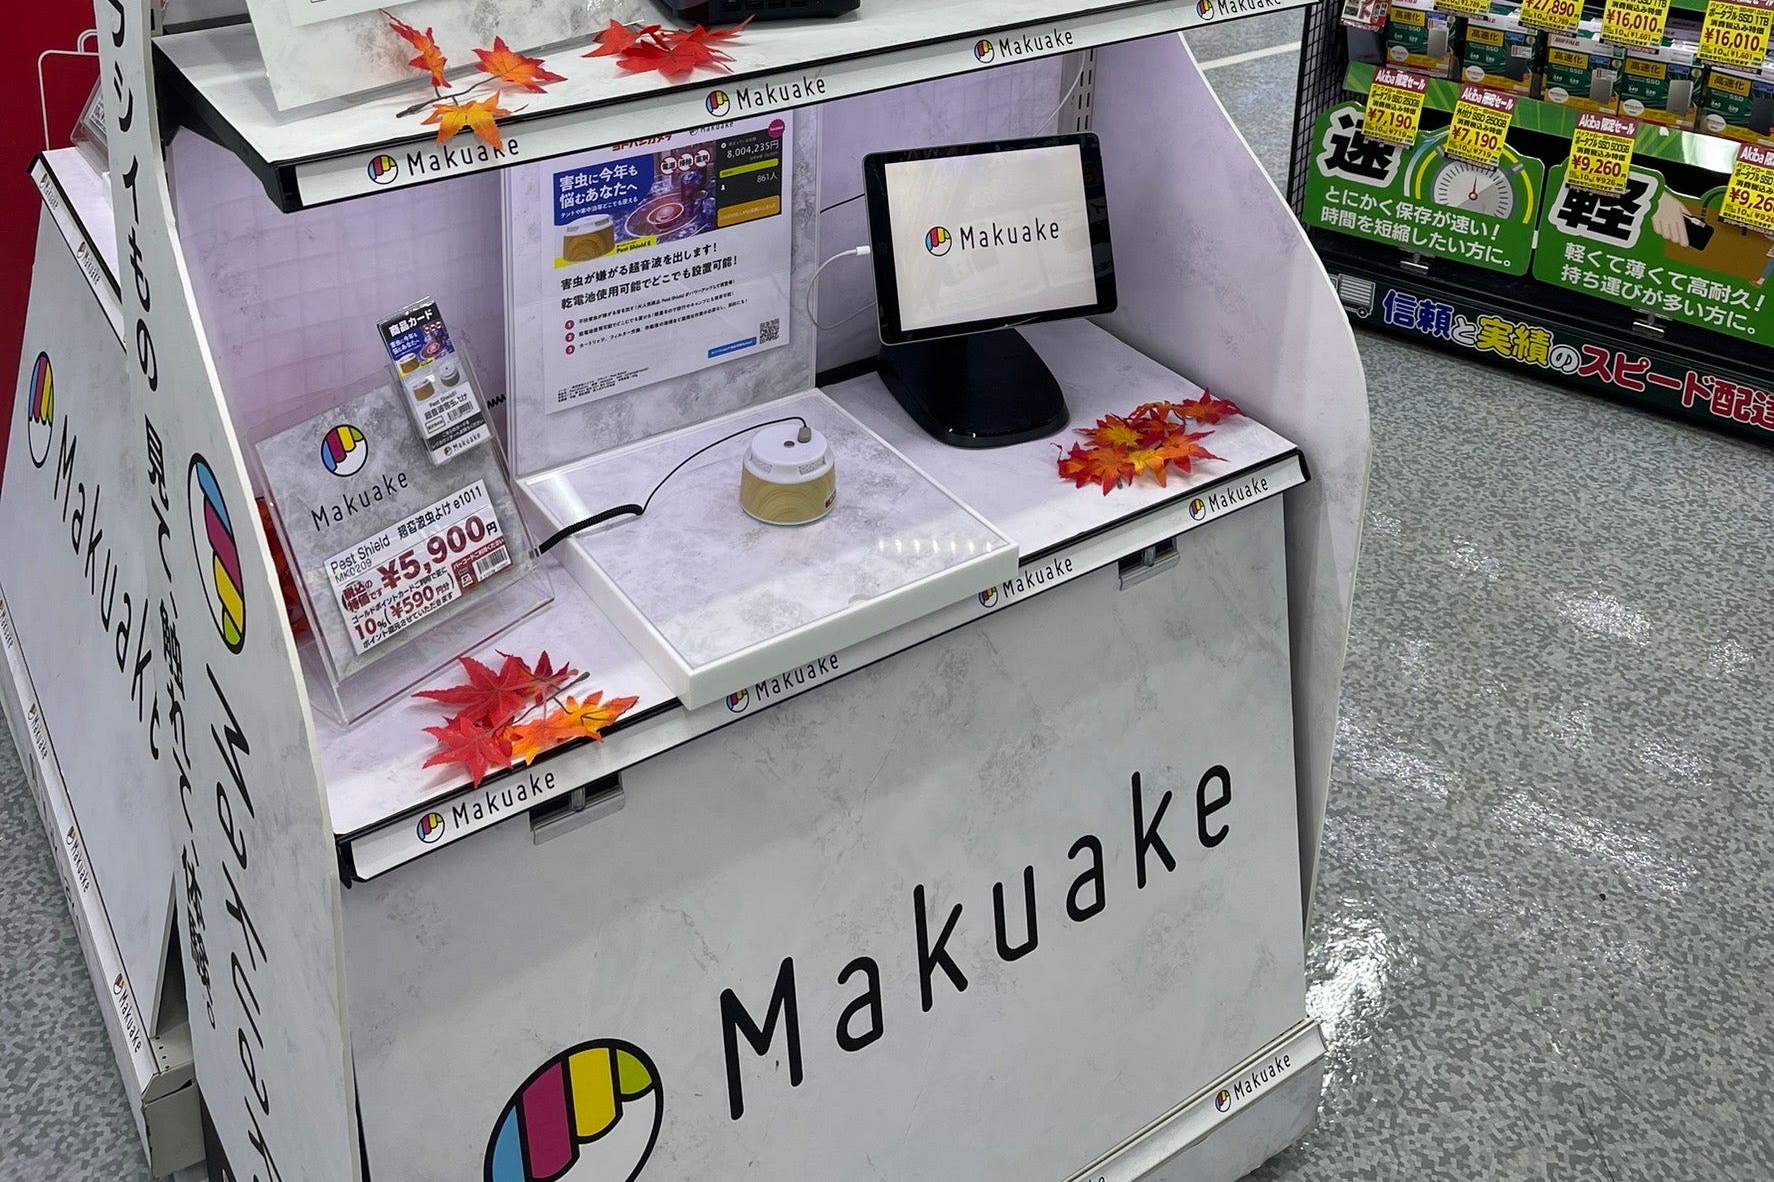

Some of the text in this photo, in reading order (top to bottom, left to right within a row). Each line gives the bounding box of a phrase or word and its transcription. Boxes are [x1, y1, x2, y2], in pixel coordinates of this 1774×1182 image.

[999, 28, 1074, 58] Makuake
[1553, 51, 1584, 65] 高速化
[1376, 69, 1396, 84] Akiba
[1630, 60, 1661, 74] 高速化
[1714, 75, 1745, 90] 高速化
[736, 75, 827, 110] Makuake
[1461, 87, 1482, 102] Akiba
[1578, 114, 1600, 129] Akiba
[1740, 146, 1764, 163] Akiba
[559, 164, 638, 193] 害虫に今年も
[756, 172, 779, 184] 861人
[559, 183, 638, 210] 悩むあなたへ
[1325, 185, 1500, 240] とにかく保存が速い！
[959, 218, 1060, 250] Makuake
[1320, 206, 1511, 268] 時間を短縮したい方に。
[1564, 242, 1766, 312] 軽くて薄くて高耐久！
[1560, 264, 1757, 335] 持ち運びが多い方に。
[388, 308, 433, 337] 商品カード
[452, 432, 481, 453] Makuake
[311, 471, 408, 532] Makuake
[1207, 476, 1268, 512] Makuake
[330, 556, 355, 575] Pest
[357, 535, 391, 562] Shield
[334, 559, 373, 584] MK0209
[1002, 556, 1073, 598] Makuake
[755, 651, 839, 702] Makuake
[452, 769, 556, 831] Makuake
[70, 839, 90, 894] Makuake
[206, 663, 283, 1182] Makuak
[719, 764, 1232, 1121] Makuake
[118, 988, 142, 1054] Makuake
[1233, 1053, 1292, 1101] Makuake
